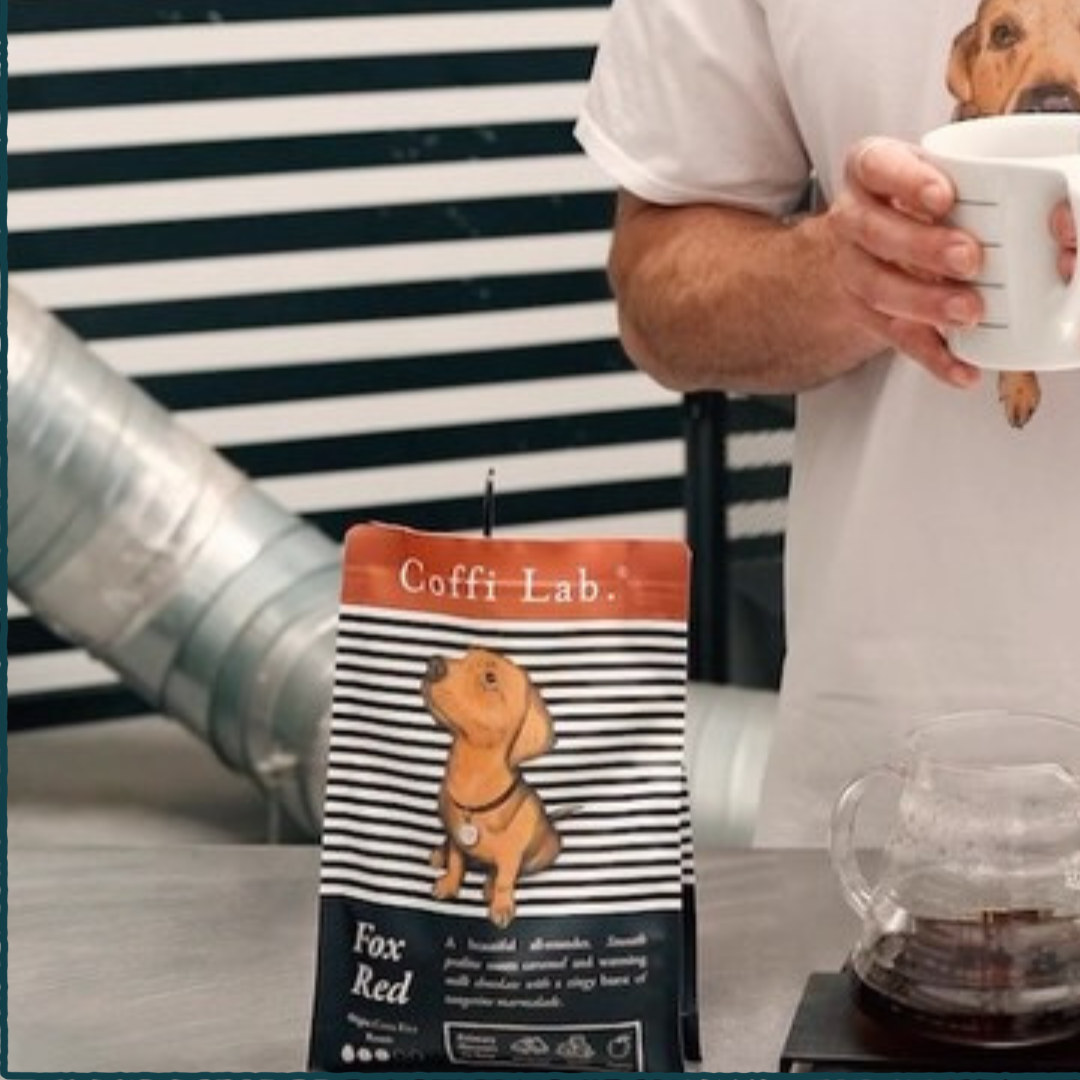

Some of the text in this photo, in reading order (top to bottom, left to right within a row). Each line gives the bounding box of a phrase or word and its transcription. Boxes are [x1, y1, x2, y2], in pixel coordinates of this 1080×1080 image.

[400, 558, 617, 603] Coffi Lab.
[353, 921, 407, 962] Fox
[350, 962, 414, 1005] Red
